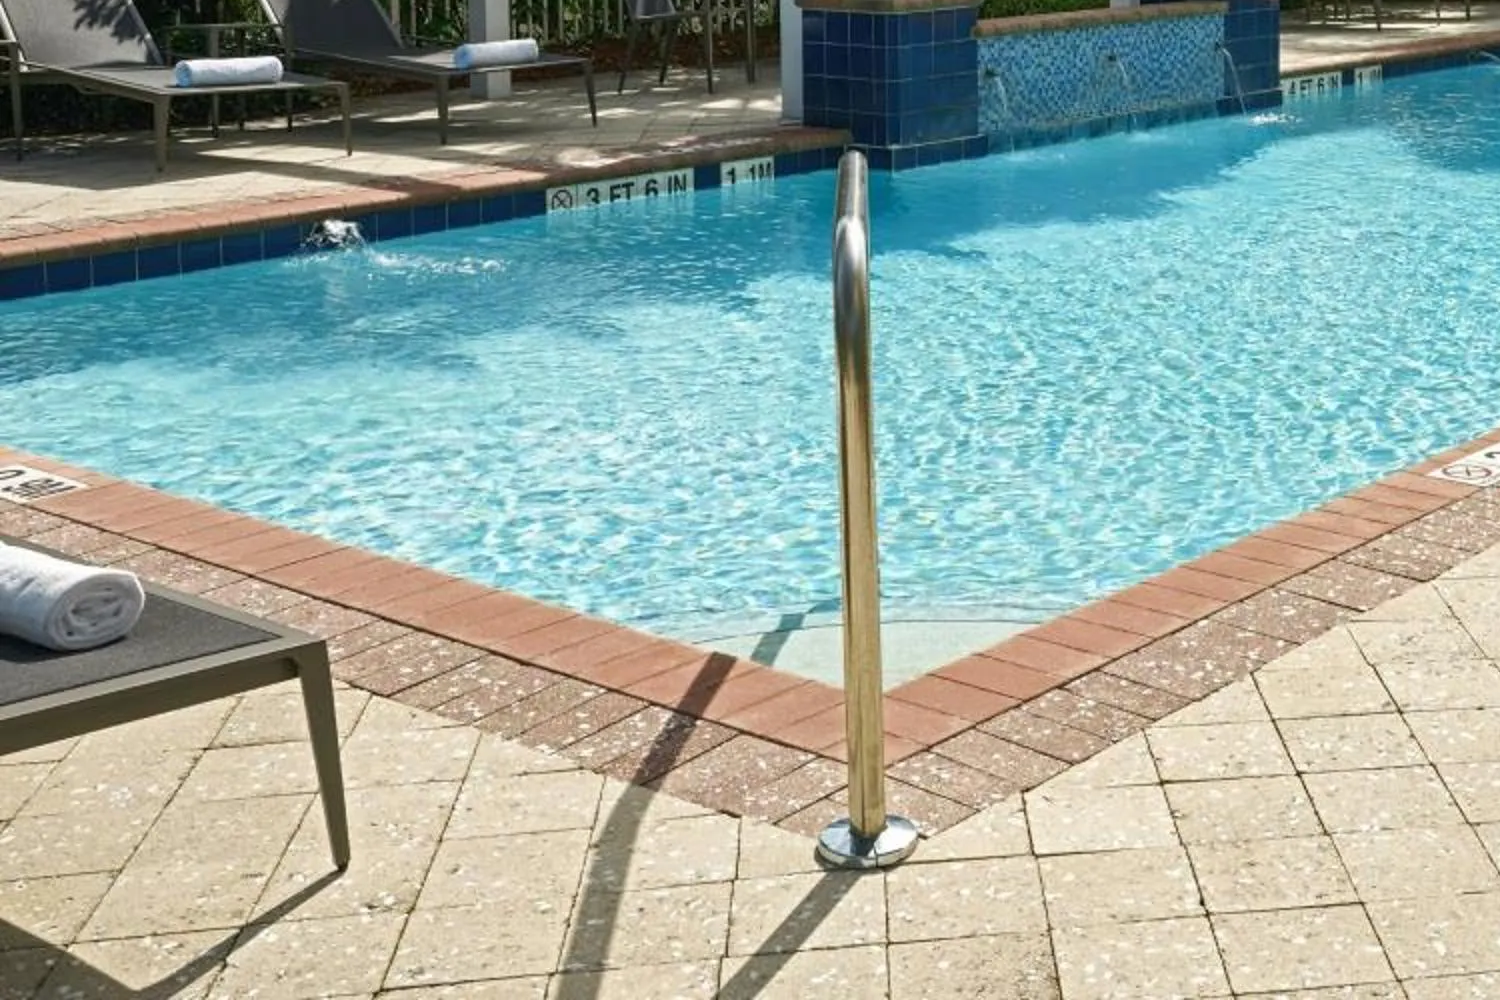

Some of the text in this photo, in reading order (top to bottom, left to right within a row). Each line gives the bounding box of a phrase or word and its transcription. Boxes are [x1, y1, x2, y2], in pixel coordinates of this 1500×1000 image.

[586, 173, 687, 205] 3 FT 6 IN
